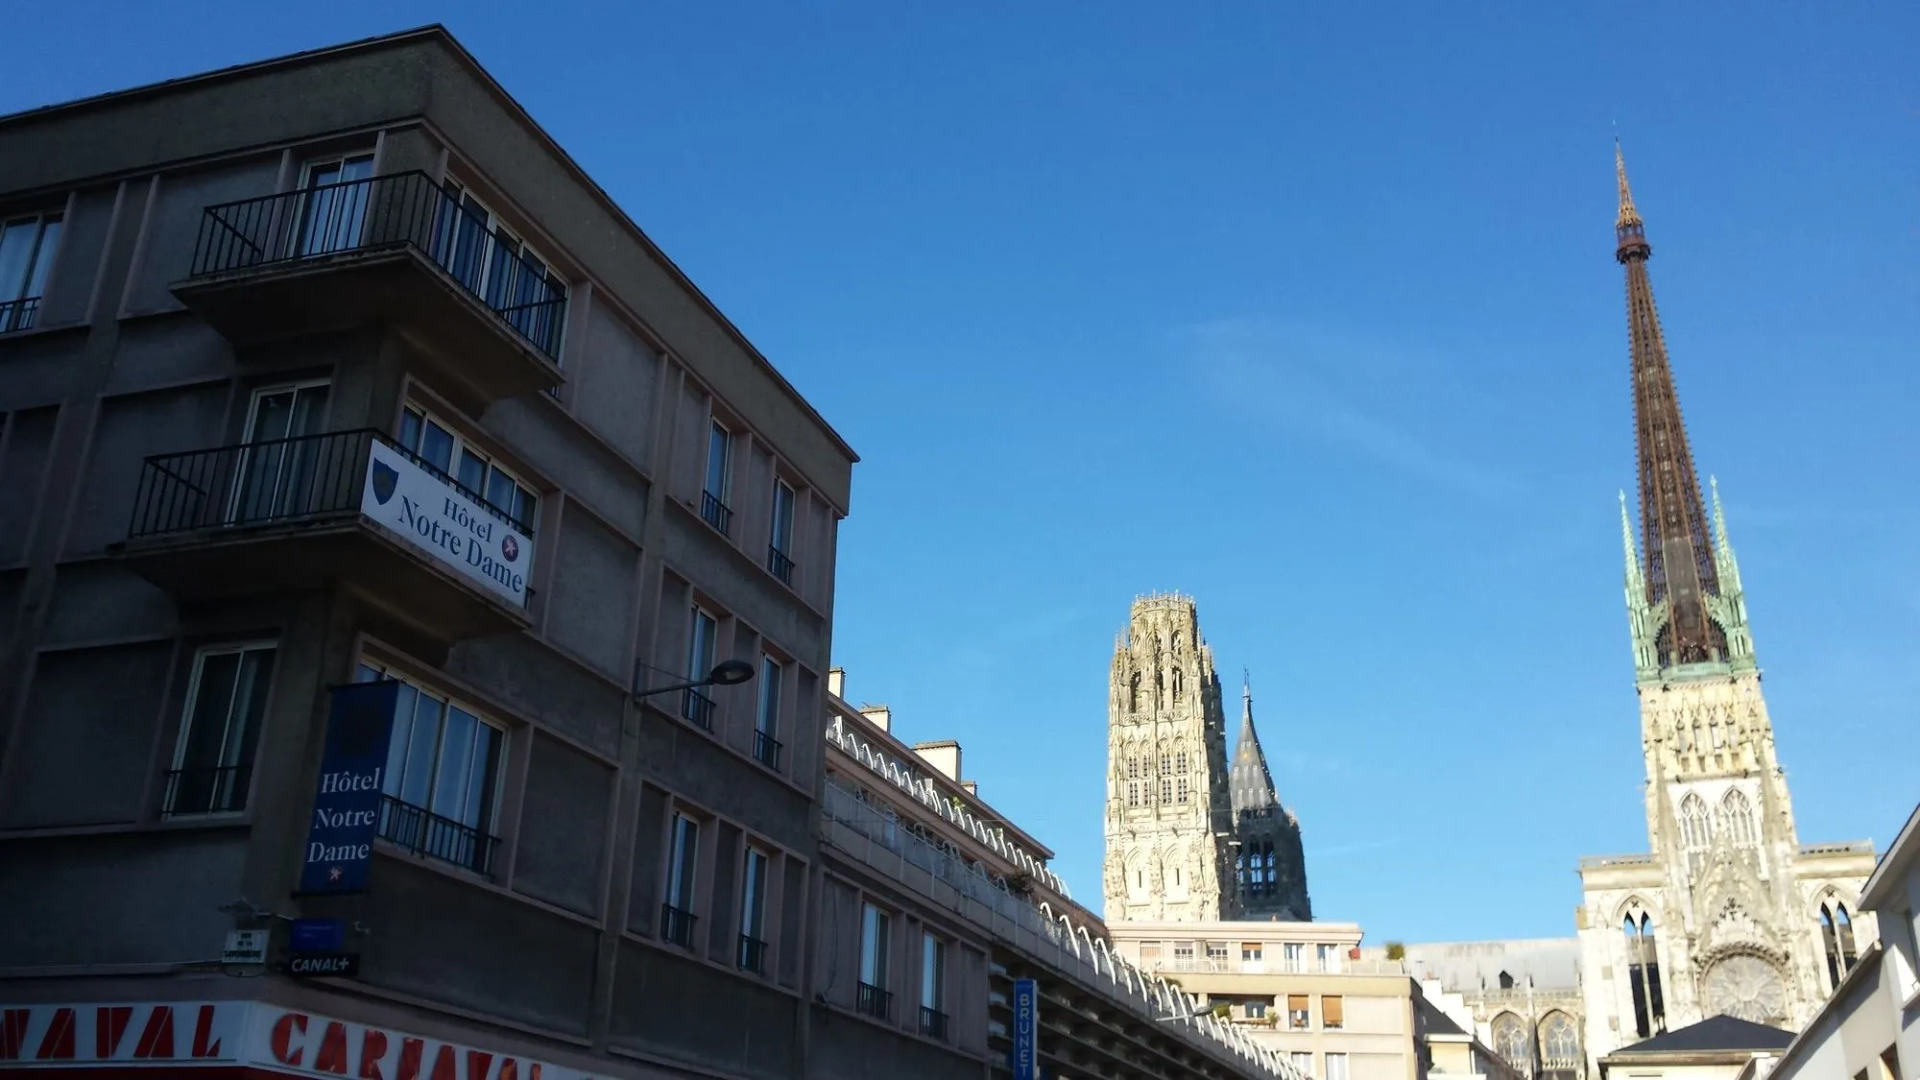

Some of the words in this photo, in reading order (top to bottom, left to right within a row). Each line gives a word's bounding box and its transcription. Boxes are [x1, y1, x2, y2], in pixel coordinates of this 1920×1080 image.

[443, 497, 492, 543] Hôtel
[398, 495, 461, 555] Notre
[466, 537, 522, 593] Dame
[321, 767, 381, 794] Hôtel
[314, 807, 375, 830] Notre
[307, 841, 369, 863] Dame
[290, 957, 350, 973] CANAL+
[1019, 993, 1030, 1077] BRUNET
